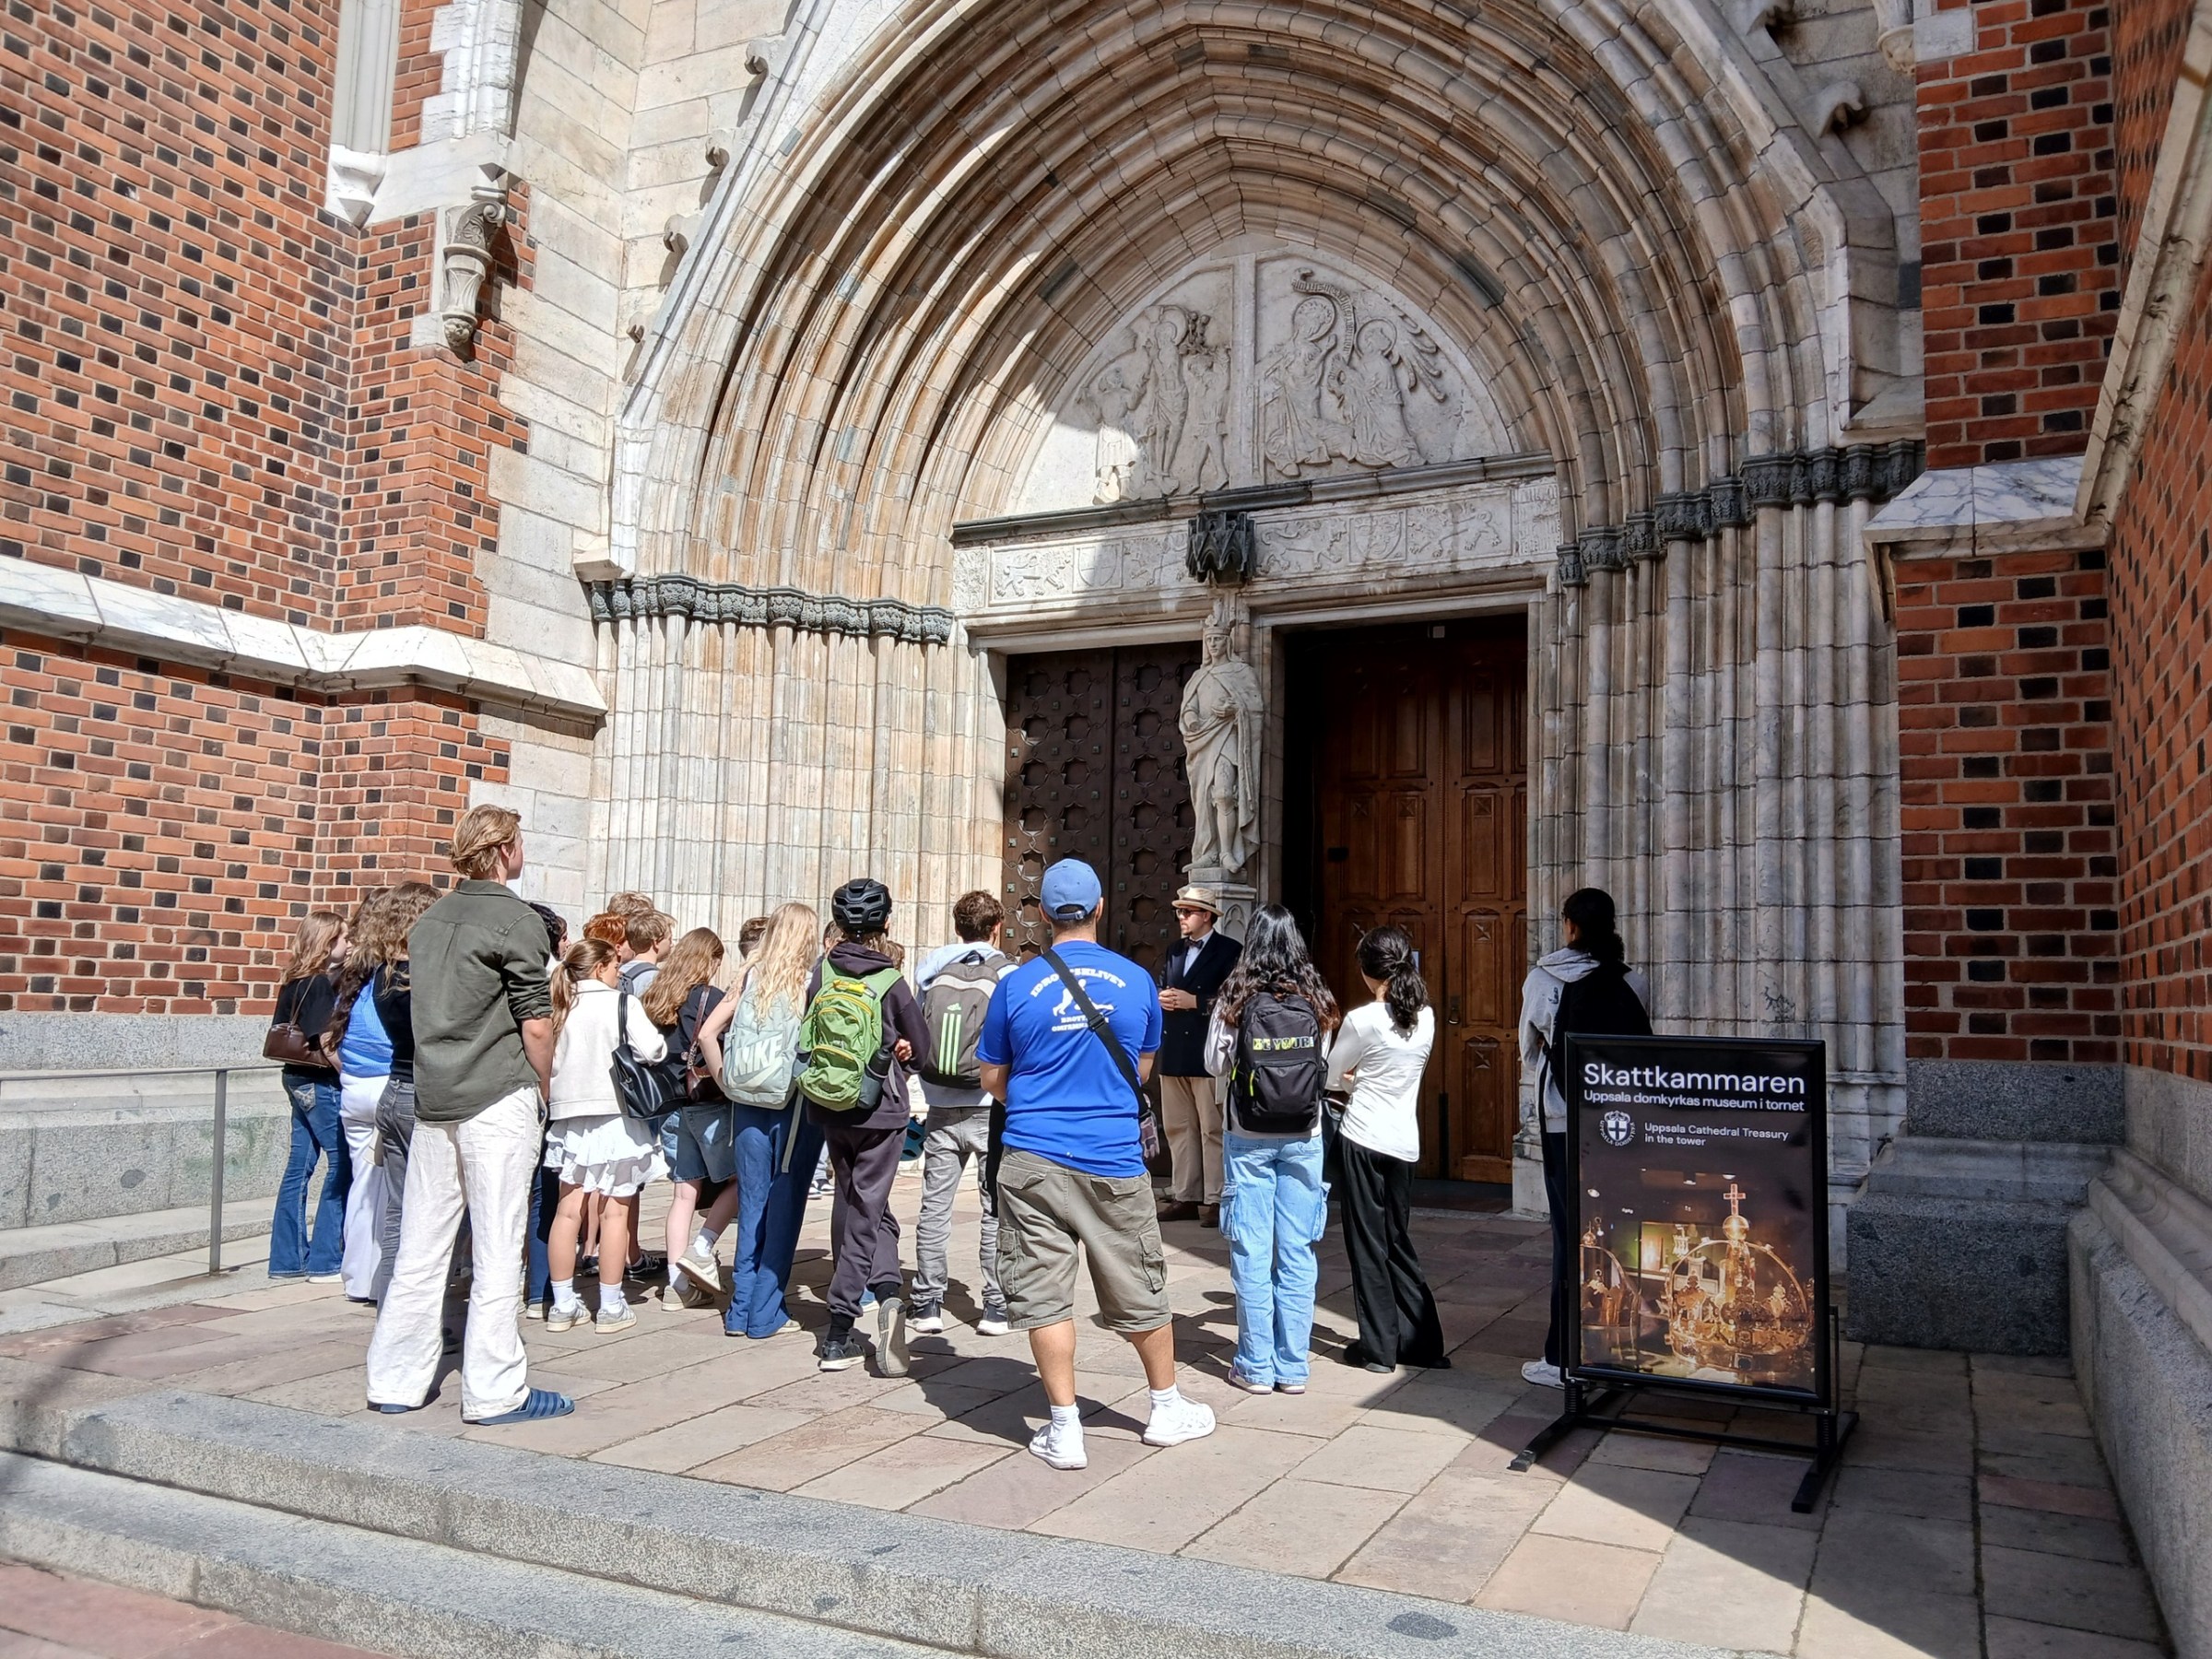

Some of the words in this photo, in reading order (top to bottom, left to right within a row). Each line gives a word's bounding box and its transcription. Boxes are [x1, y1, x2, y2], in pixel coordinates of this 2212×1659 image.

[733, 1033, 783, 1077] NIKE
[1253, 1038, 1272, 1051] BE
[1583, 1063, 1806, 1095] Skattkammaren
[1583, 1089, 1631, 1104] Uppsala
[1633, 1092, 1701, 1108] domkyrkas
[1702, 1098, 1758, 1110] museum
[1759, 1098, 1764, 1110] i
[1765, 1100, 1806, 1112] tornet
[1644, 1122, 1686, 1135] Uppsala
[1688, 1124, 1740, 1136] Cathedral
[1742, 1127, 1789, 1142] Treasury
[1644, 1133, 1654, 1143] in
[1657, 1135, 1674, 1144] the
[1677, 1136, 1706, 1147] tower
